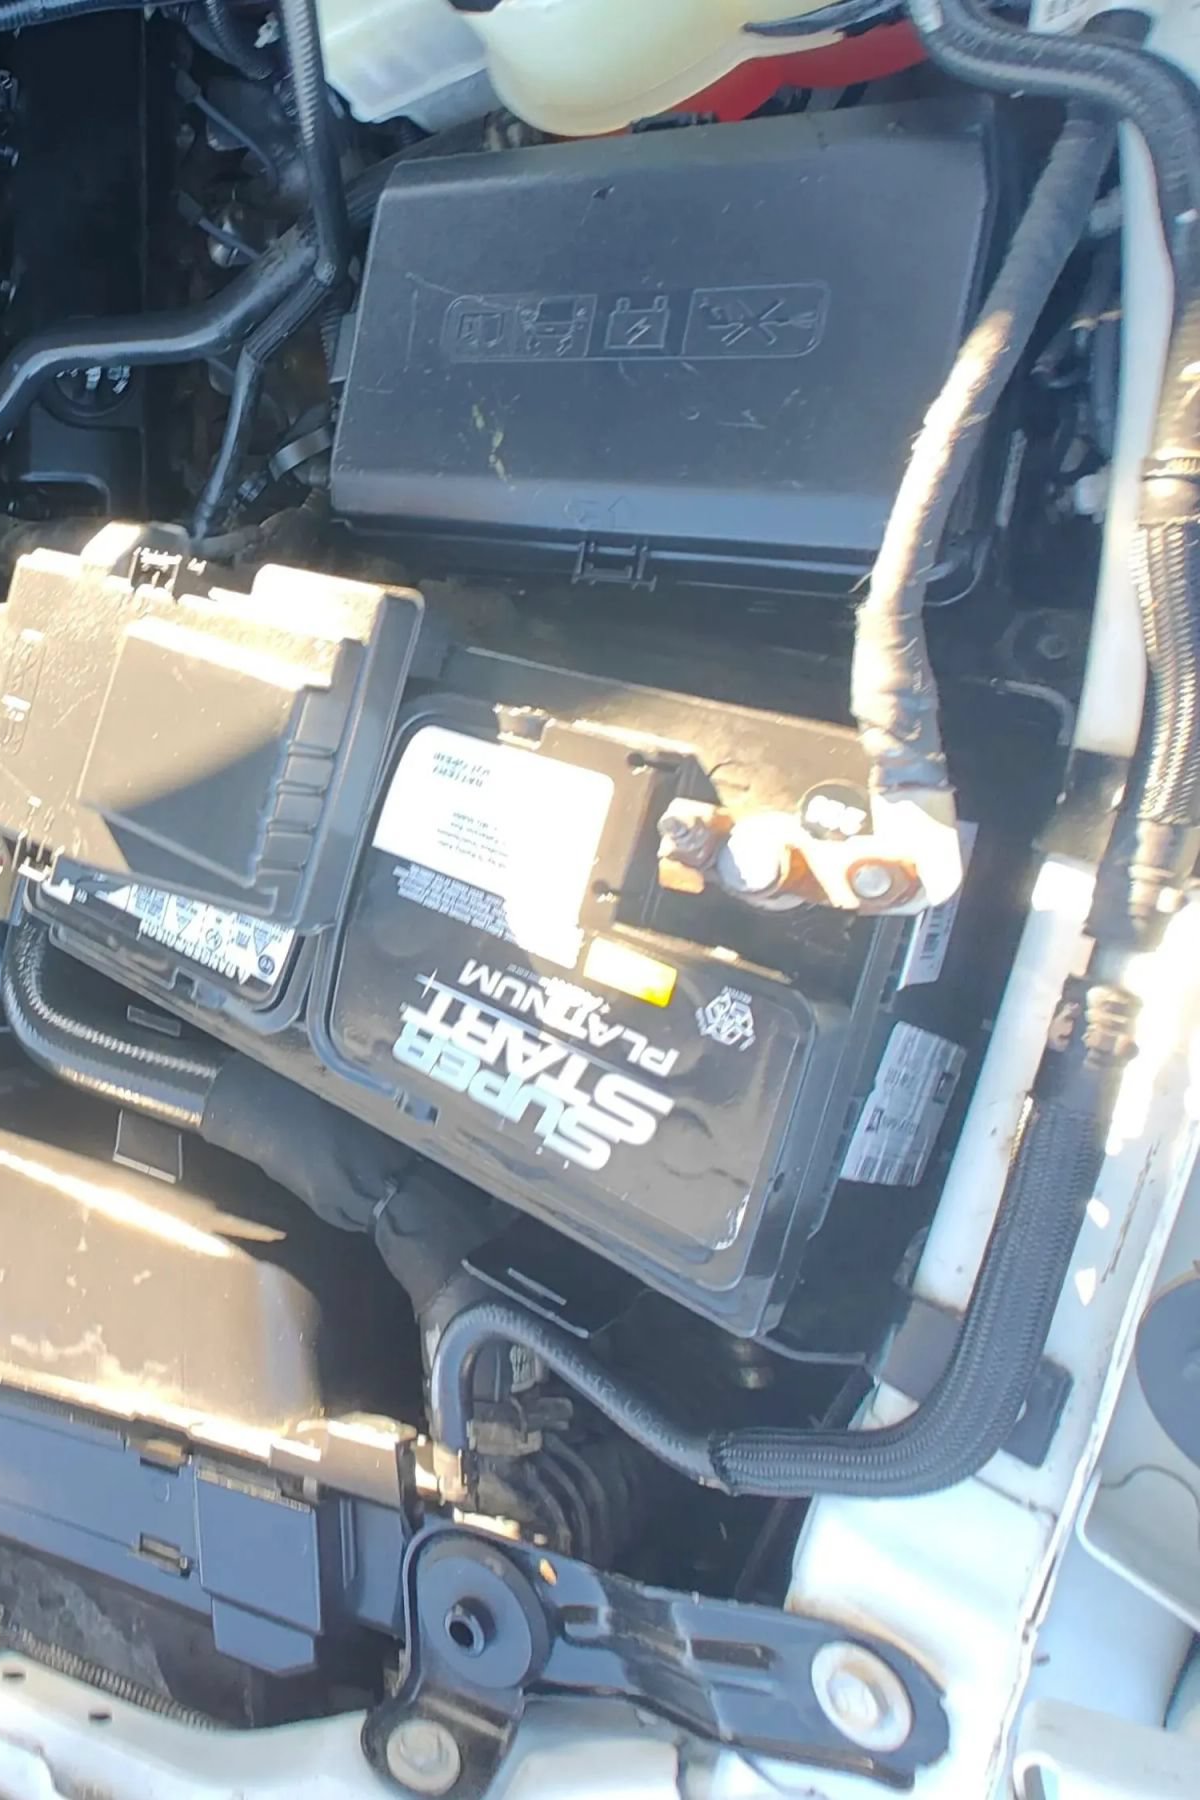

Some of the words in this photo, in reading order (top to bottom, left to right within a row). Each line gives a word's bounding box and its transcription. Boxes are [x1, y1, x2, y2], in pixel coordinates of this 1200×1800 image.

[401, 985, 675, 1146] START
[457, 958, 680, 1078] PLATINUM
[391, 1021, 612, 1171] SUPER
